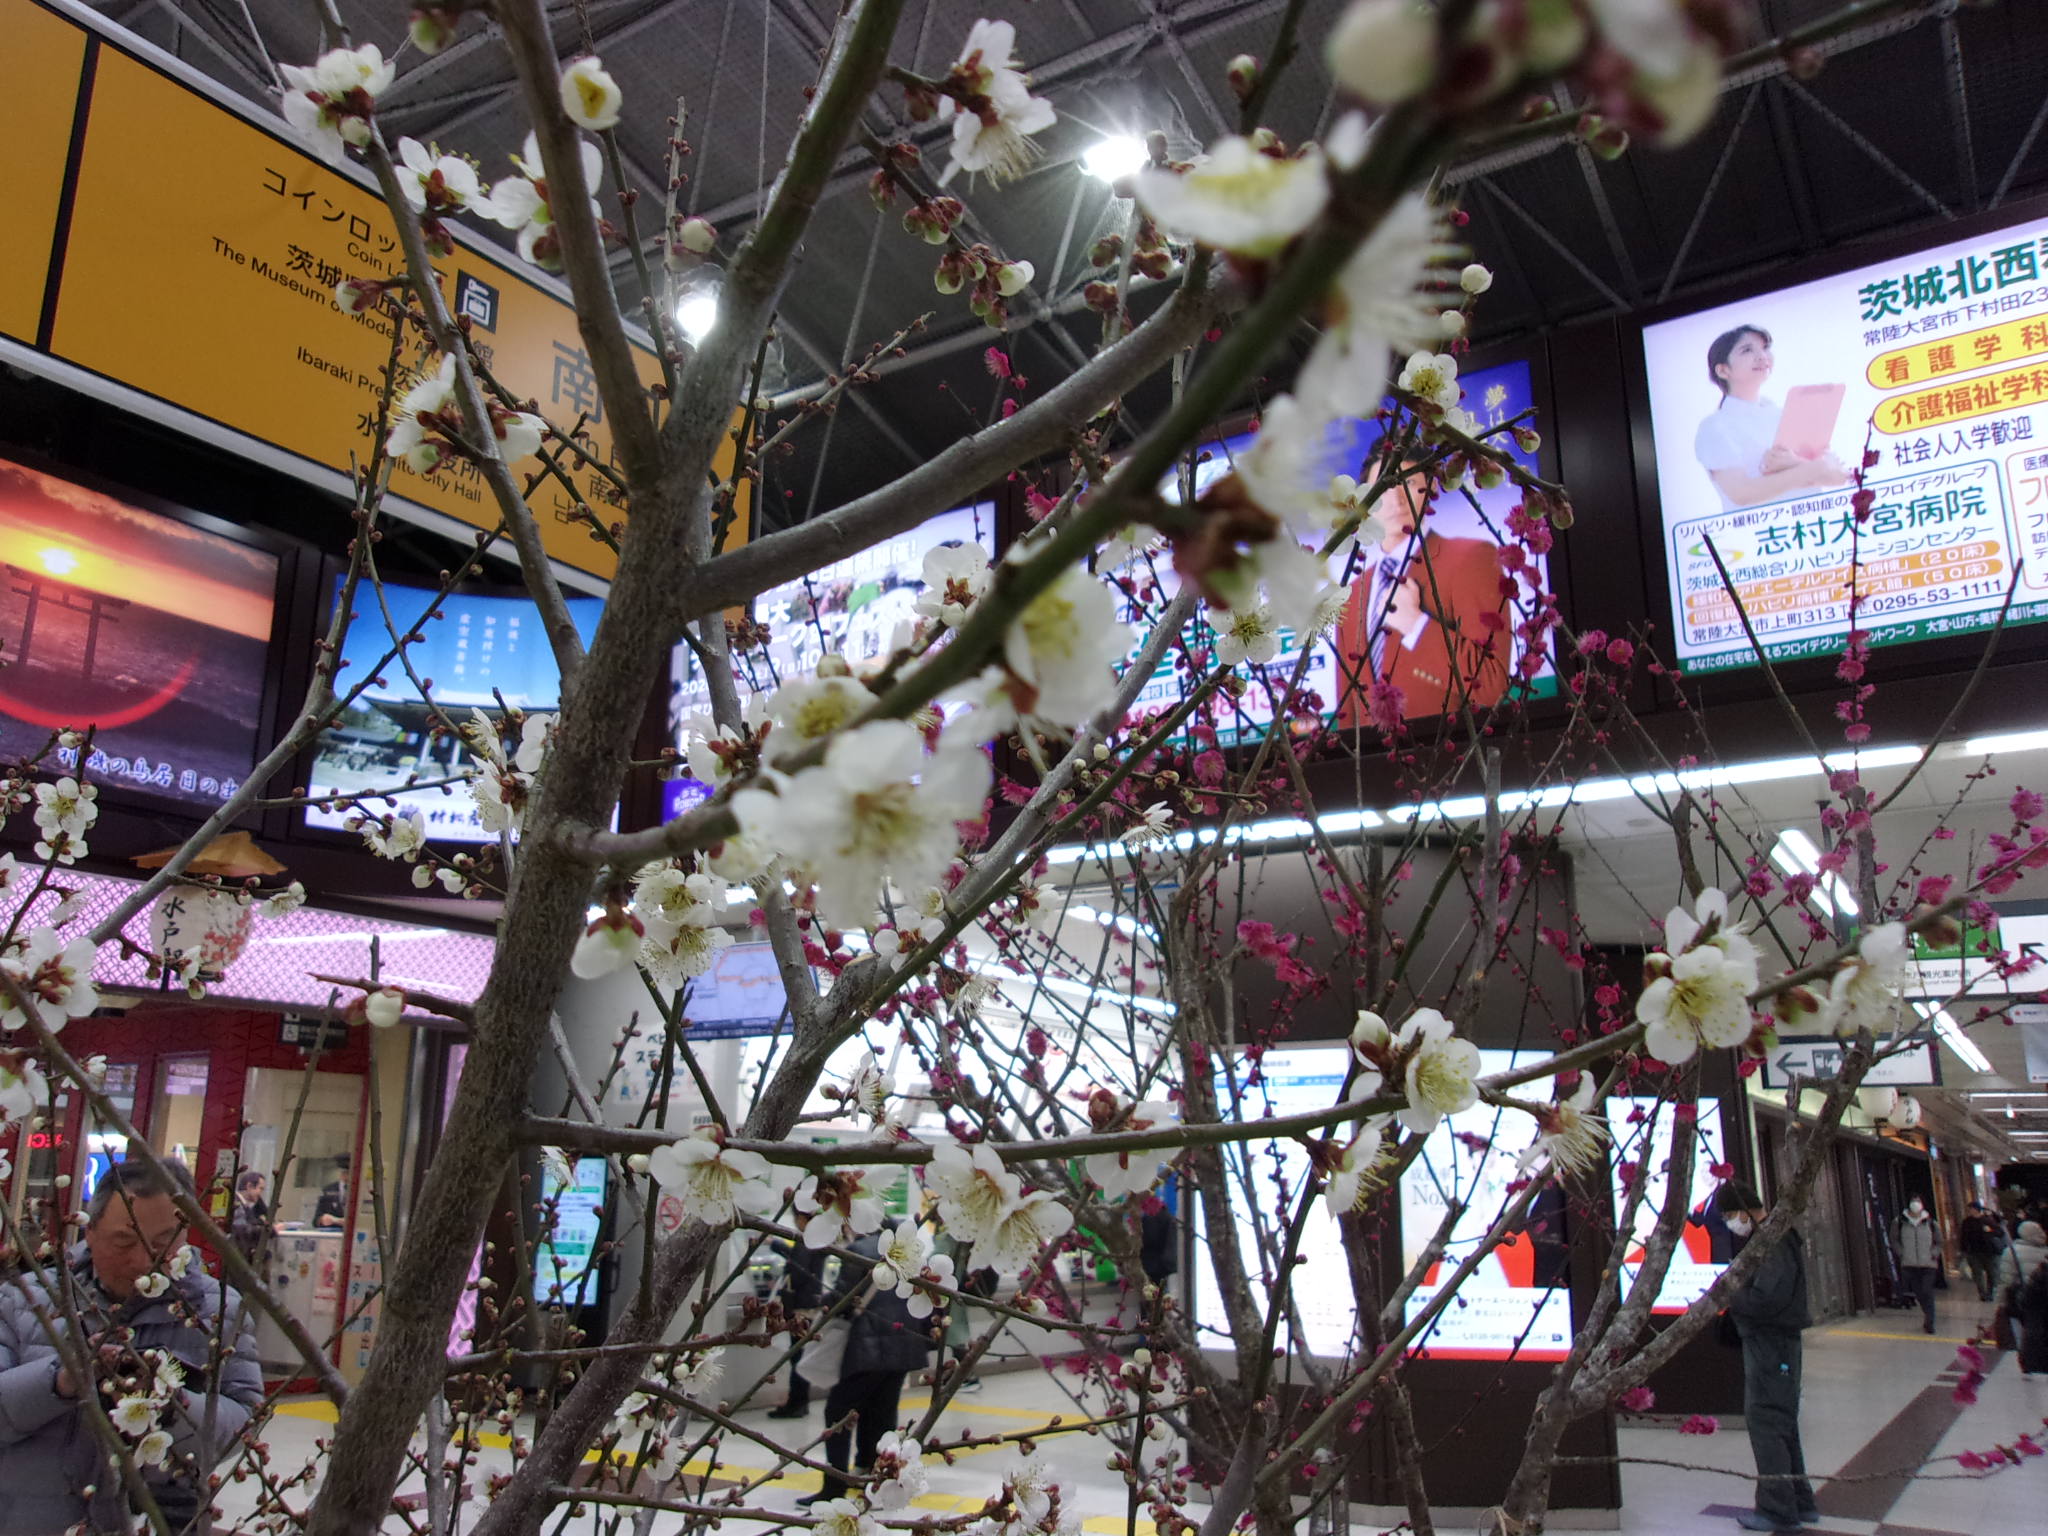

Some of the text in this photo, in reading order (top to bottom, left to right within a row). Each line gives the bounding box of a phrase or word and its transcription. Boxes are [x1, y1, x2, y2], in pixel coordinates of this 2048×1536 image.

[346, 242, 383, 273] Coin
[212, 236, 246, 265] The
[251, 257, 327, 305] Museum
[351, 312, 410, 348] Moden
[297, 346, 353, 384] Ibaraki
[1894, 415, 2033, 467] 社会人入学歓迎
[453, 482, 482, 503] Hall
[1755, 486, 1987, 557] 志村大宮病院
